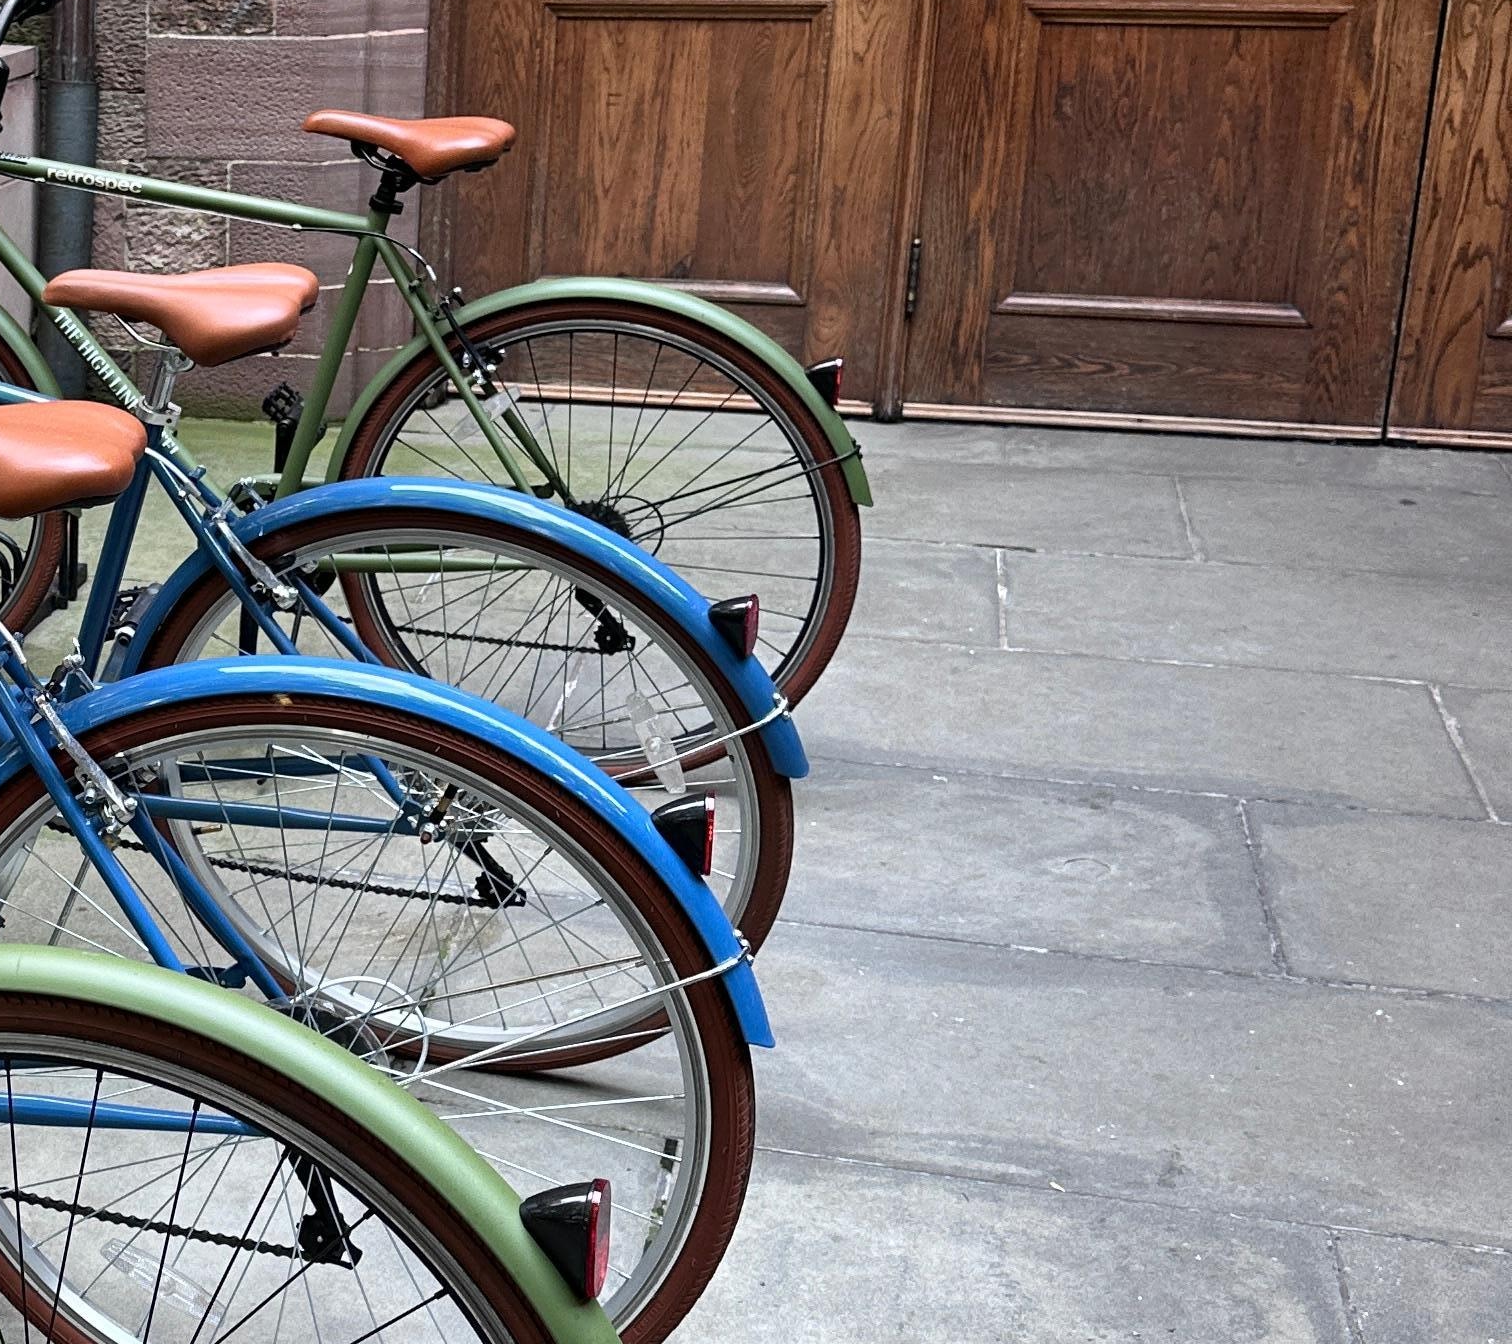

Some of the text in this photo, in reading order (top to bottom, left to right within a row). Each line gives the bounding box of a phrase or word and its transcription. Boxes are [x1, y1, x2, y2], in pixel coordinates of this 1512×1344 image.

[46, 167, 143, 194] retrospec
[54, 309, 83, 344] THE
[78, 339, 115, 381] HIGH
